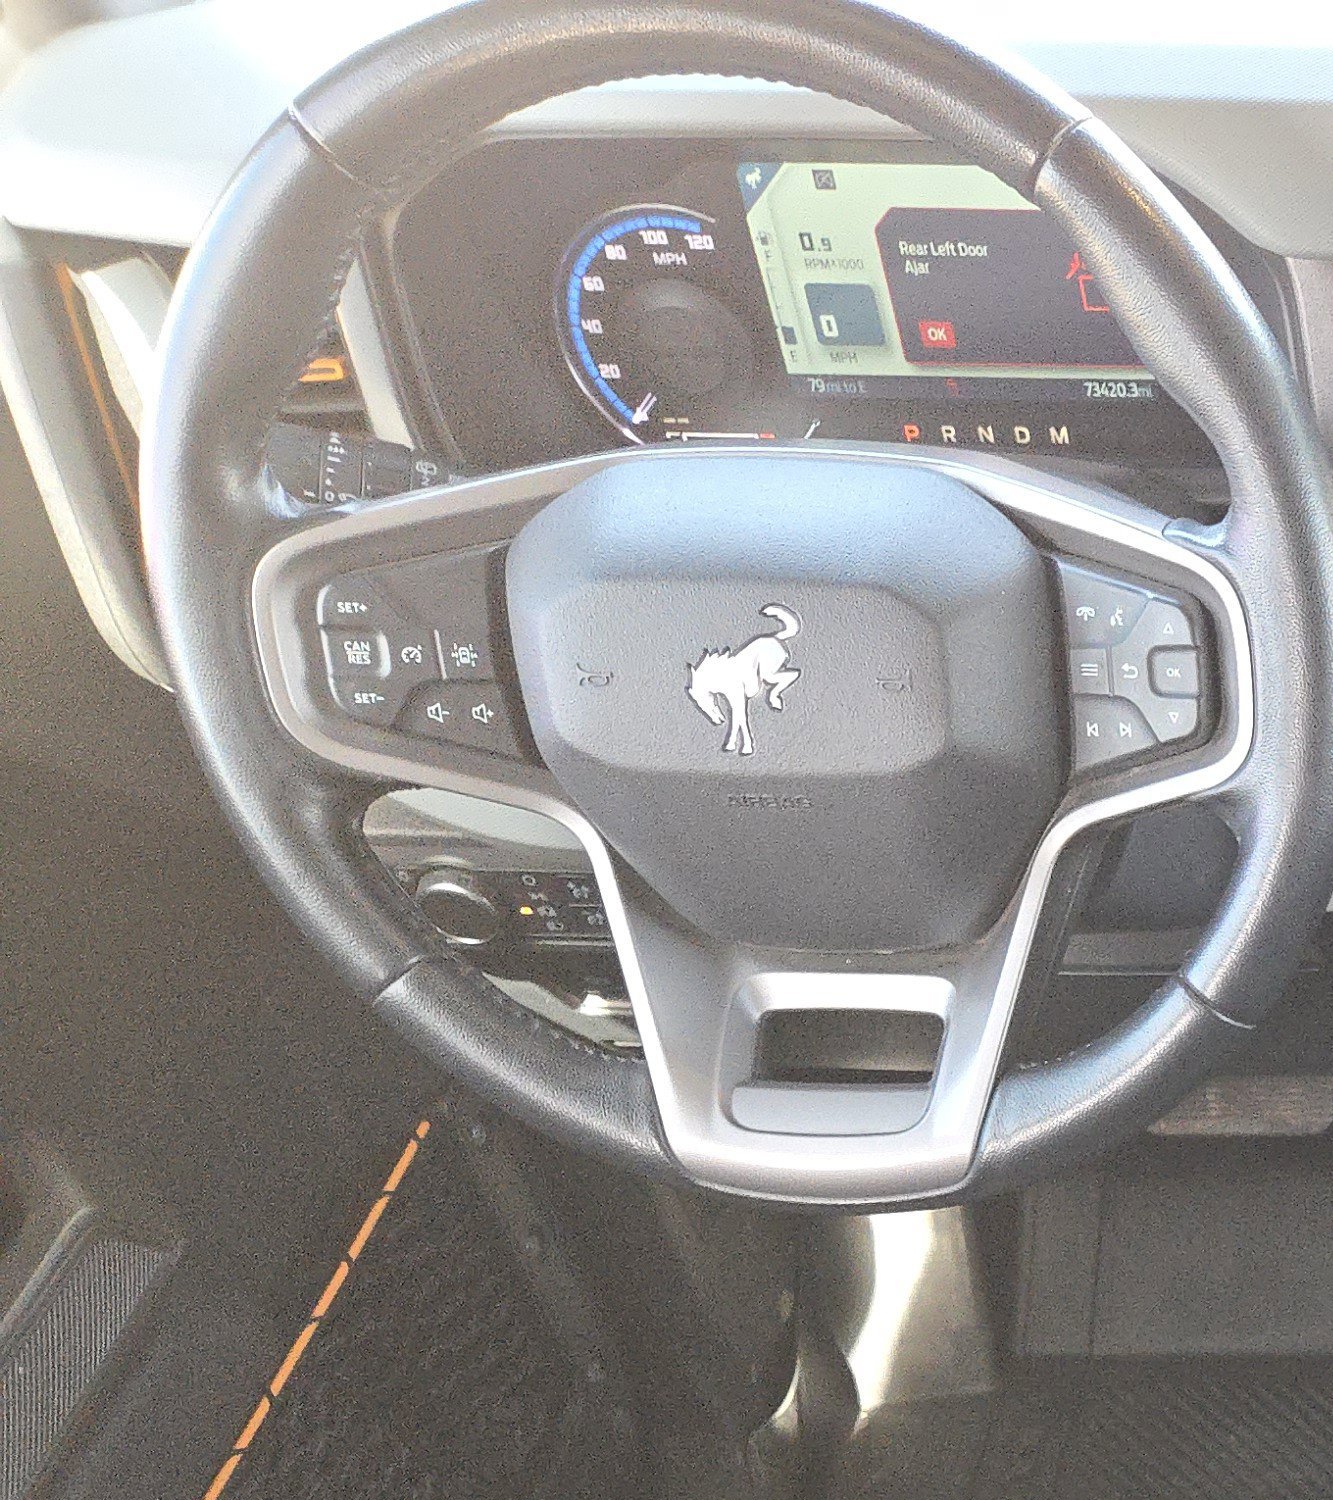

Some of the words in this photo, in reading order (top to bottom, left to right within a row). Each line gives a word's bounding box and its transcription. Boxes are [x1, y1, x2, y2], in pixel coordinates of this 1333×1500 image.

[639, 230, 668, 245] 100
[684, 234, 714, 251] 120
[799, 232, 832, 252] 0.9
[900, 241, 929, 256] Rear
[930, 242, 959, 257] Left
[960, 242, 988, 257] Door
[652, 251, 688, 266] MPH
[905, 261, 930, 276] Ajar
[583, 276, 605, 291] 60
[581, 319, 603, 334] 40
[819, 315, 839, 338] 0
[927, 327, 948, 342] OK
[830, 351, 859, 364] MPH
[598, 364, 621, 379] 20
[808, 377, 826, 393] 79
[903, 425, 920, 442] P
[941, 425, 956, 443] R
[978, 425, 995, 443] N
[1014, 426, 1031, 444] D
[1050, 426, 1069, 444] M
[343, 641, 371, 652] CAN
[347, 653, 371, 665] RES
[1166, 668, 1182, 679] OK
